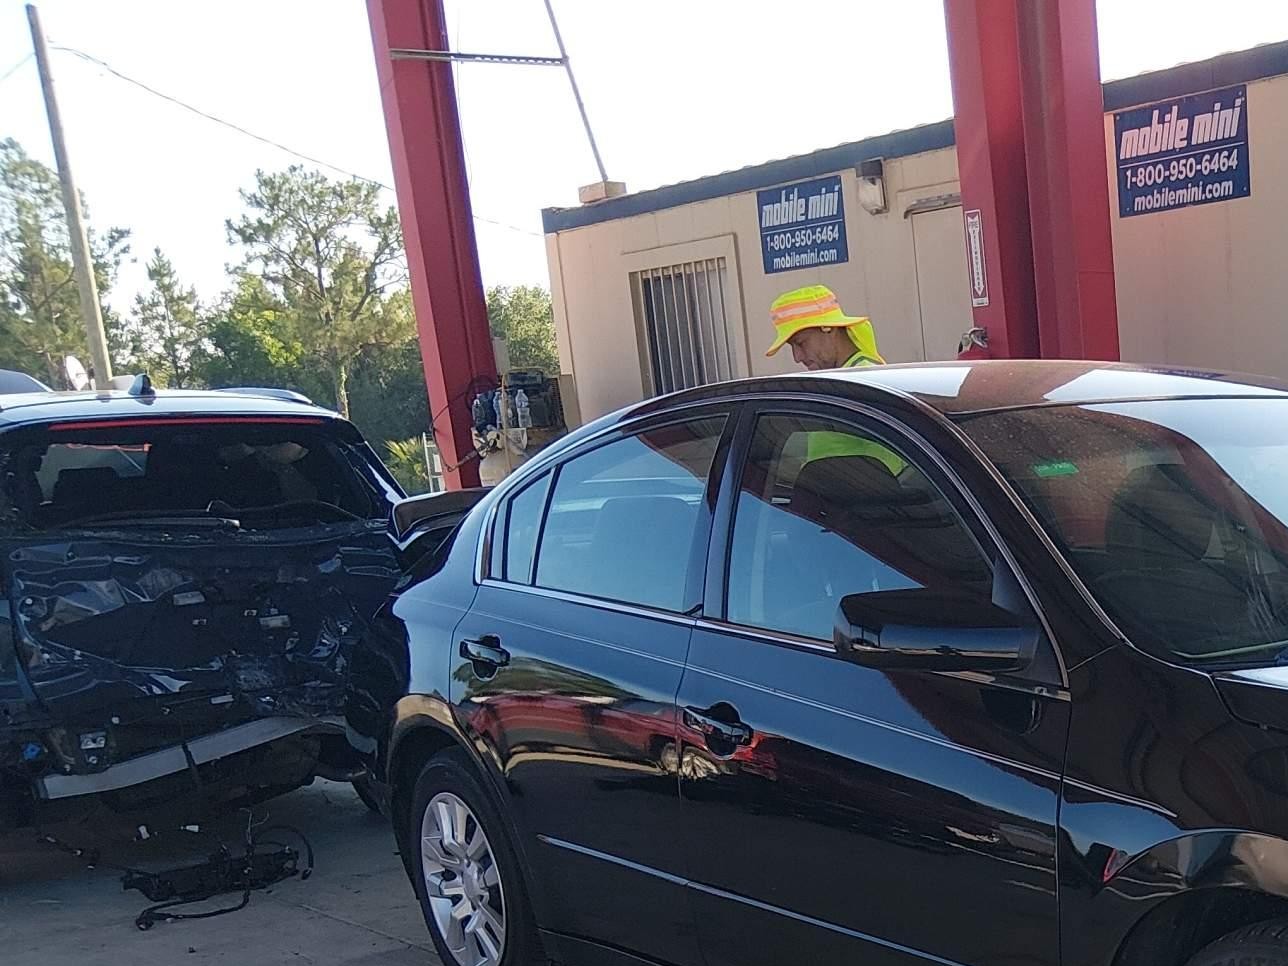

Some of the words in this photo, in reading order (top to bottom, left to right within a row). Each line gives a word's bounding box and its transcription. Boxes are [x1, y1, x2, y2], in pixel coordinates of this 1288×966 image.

[1119, 105, 1189, 160] mobile
[1191, 98, 1242, 146] mini
[1125, 148, 1238, 190] 1-800-950-6464
[761, 187, 806, 228] mobile
[807, 184, 839, 220] mini
[1134, 180, 1233, 212] mobilemini.com
[766, 223, 839, 252] 1-800-950-6464
[773, 247, 838, 270] mobilemini.com
